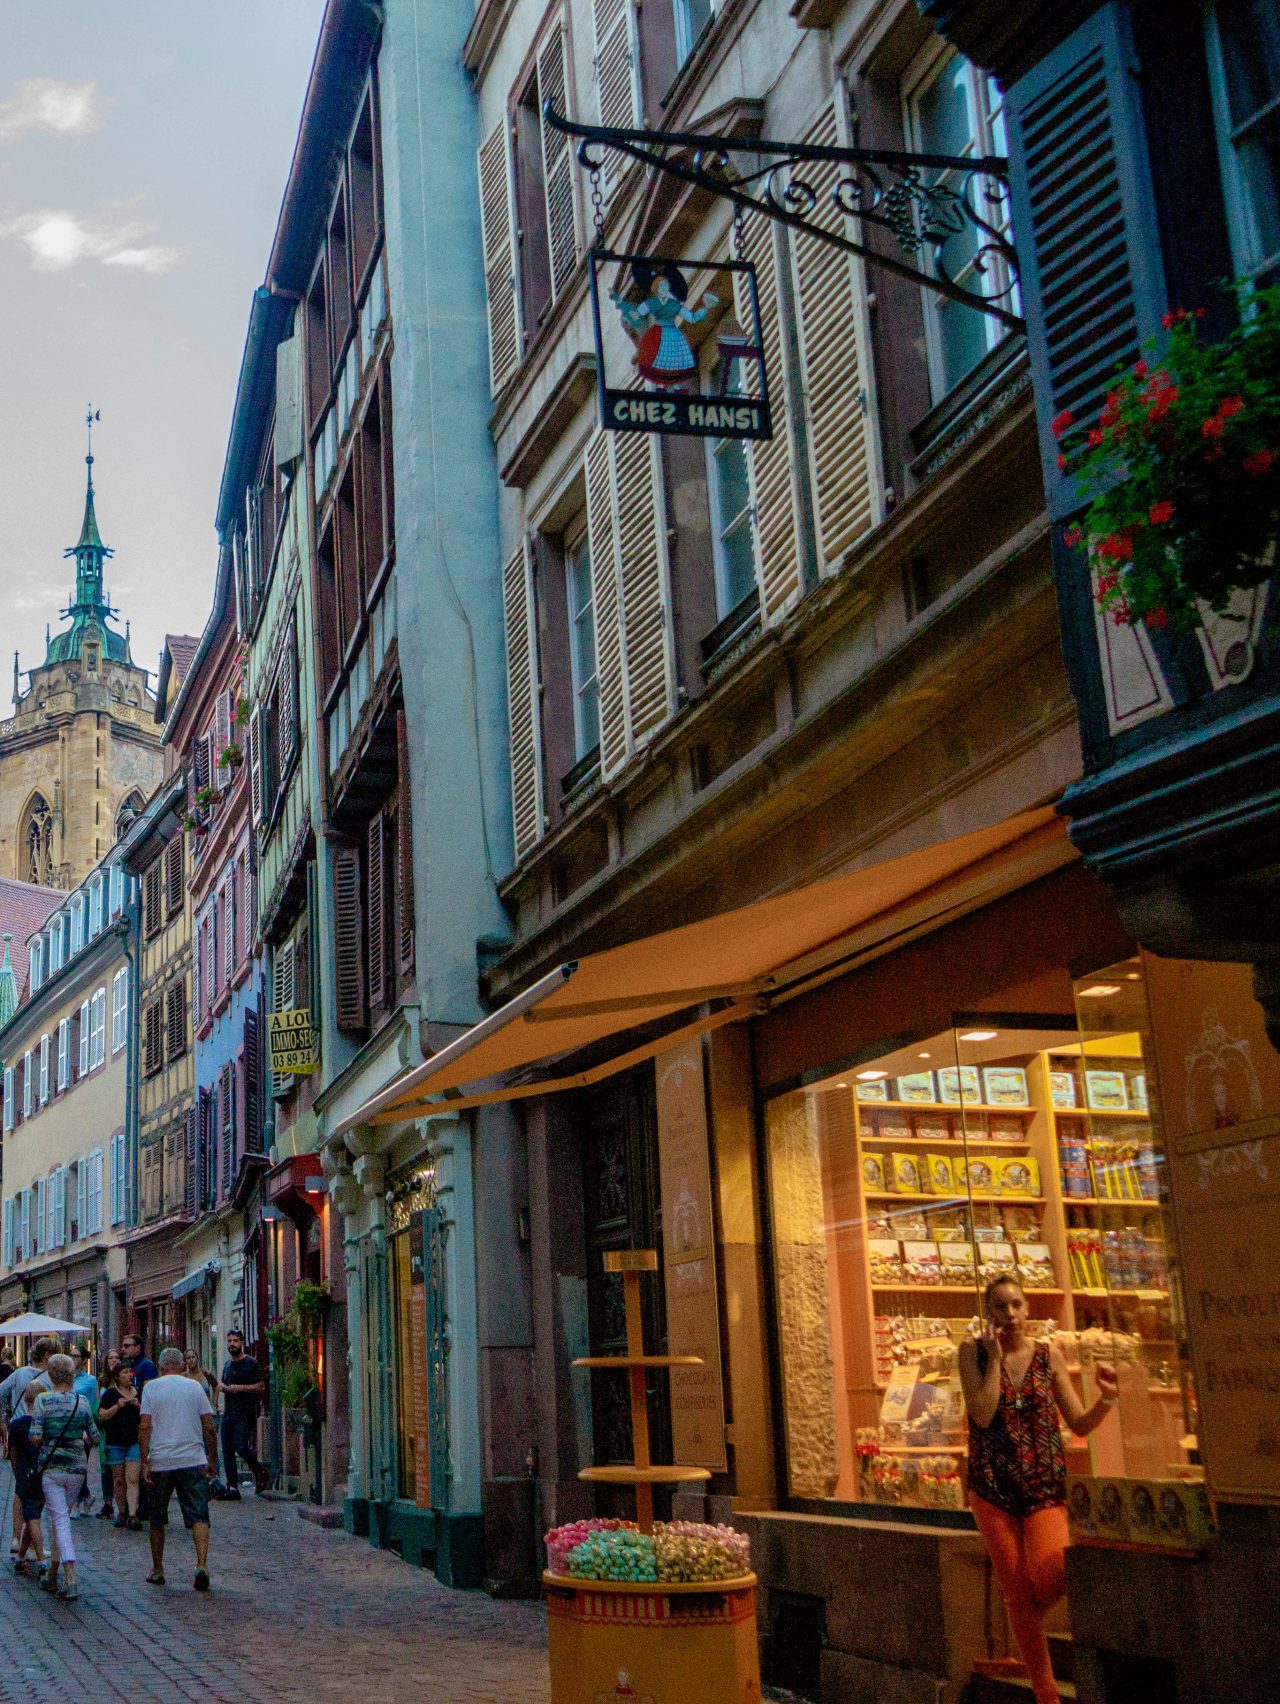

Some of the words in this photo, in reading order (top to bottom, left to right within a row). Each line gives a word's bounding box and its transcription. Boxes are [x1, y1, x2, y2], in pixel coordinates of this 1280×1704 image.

[613, 400, 676, 425] CHEZ
[688, 403, 760, 430] HANSI
[272, 1015, 282, 1029] A
[273, 1054, 285, 1068] 03
[287, 1052, 298, 1067] 89
[300, 1050, 311, 1065] 24
